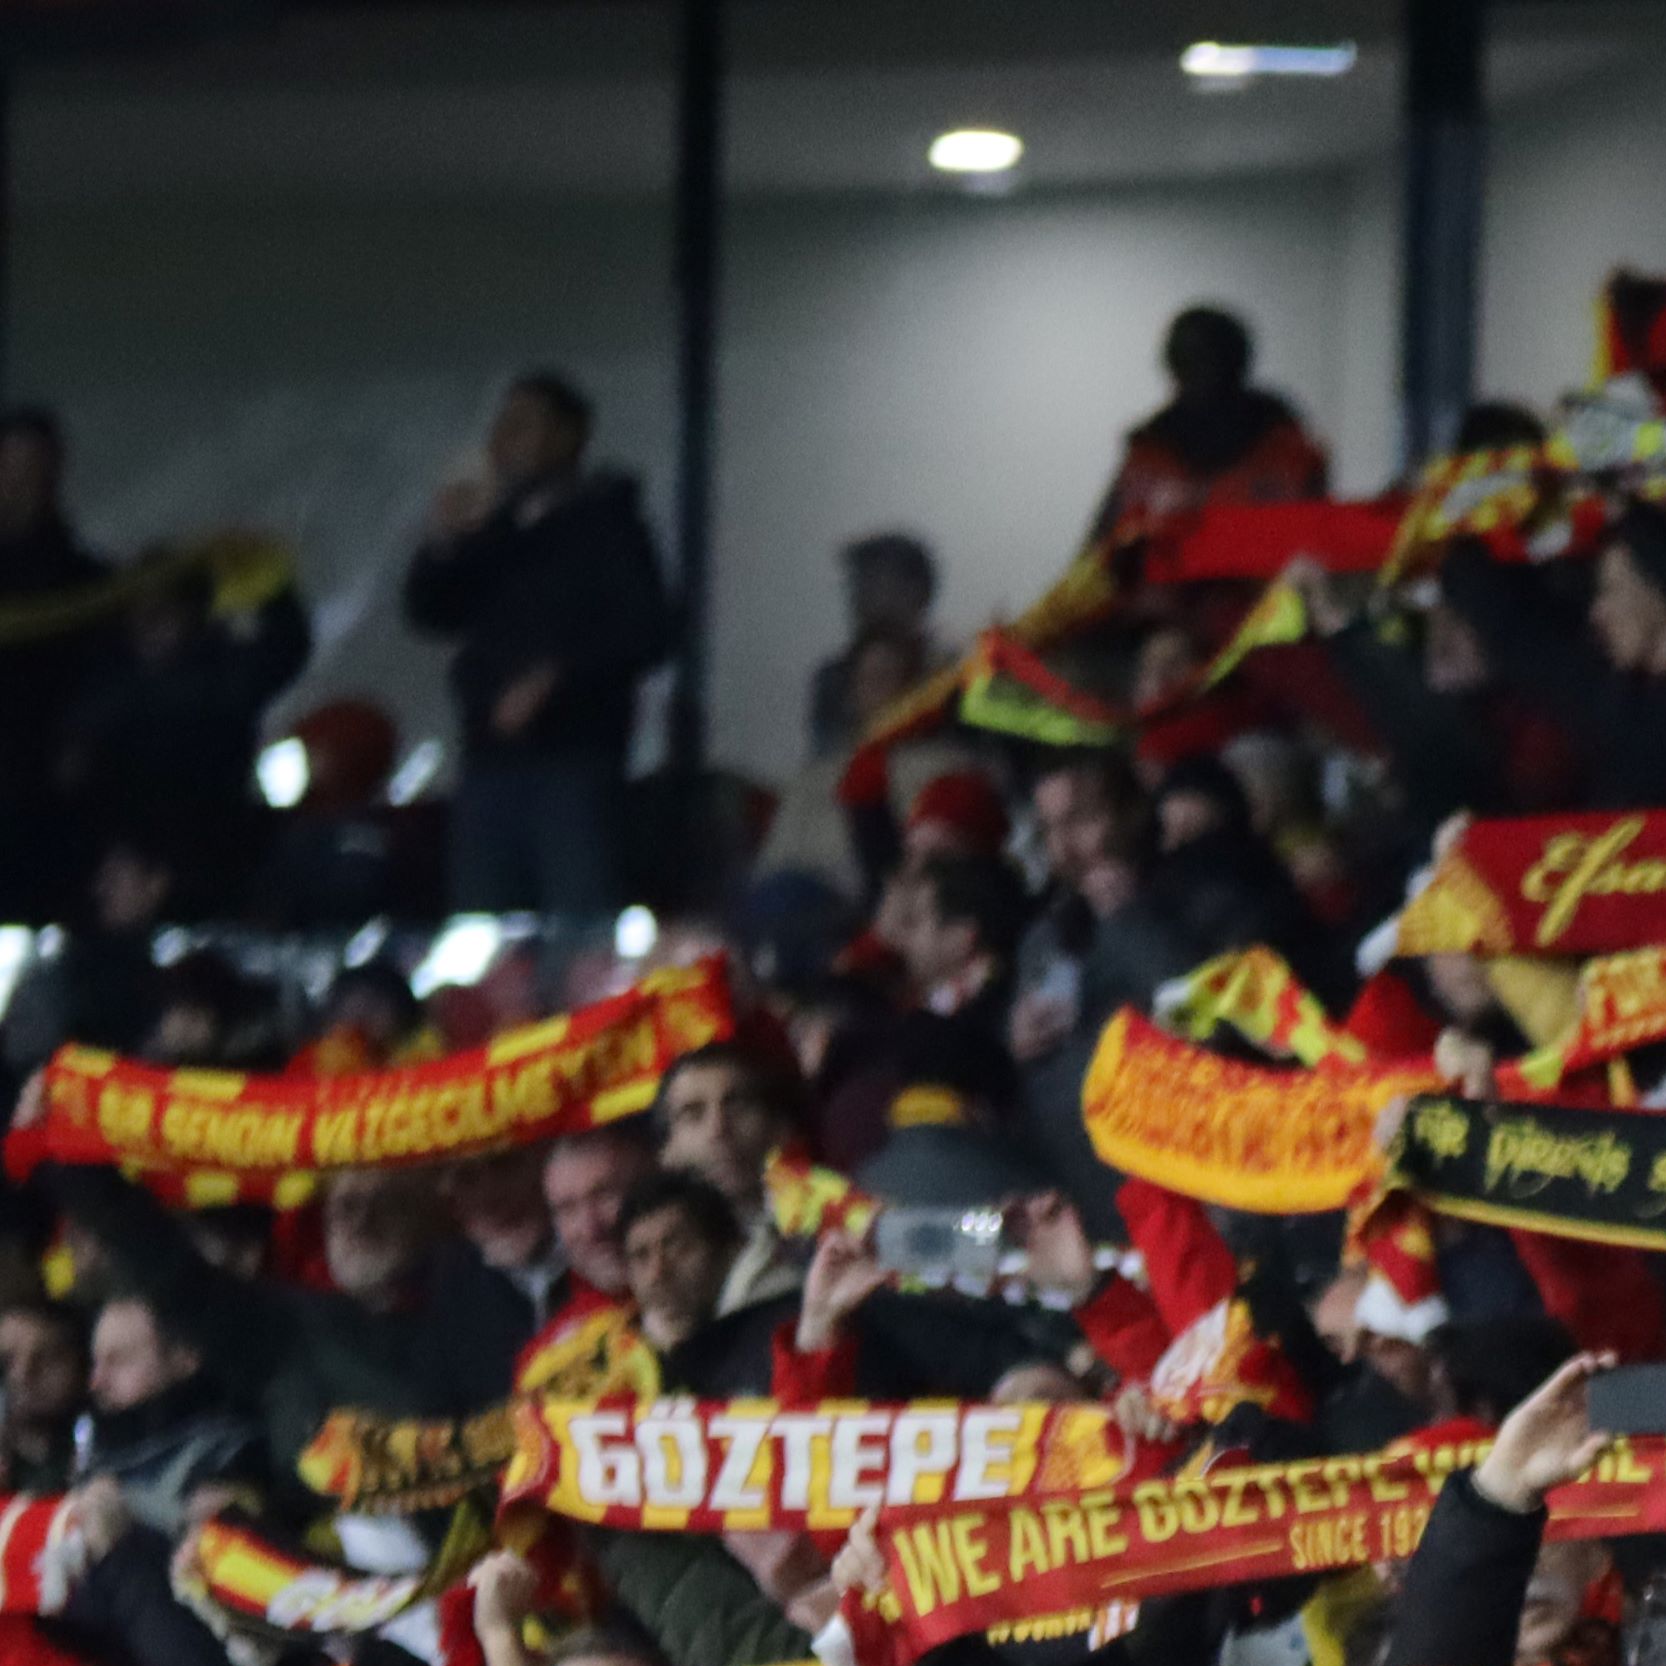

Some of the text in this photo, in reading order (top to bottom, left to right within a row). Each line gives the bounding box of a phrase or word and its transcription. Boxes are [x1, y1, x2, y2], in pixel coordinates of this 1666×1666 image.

[570, 1400, 1020, 1511] GÖZTEPE
[893, 1514, 1001, 1618] WE
[1007, 1490, 1128, 1584] ARE
